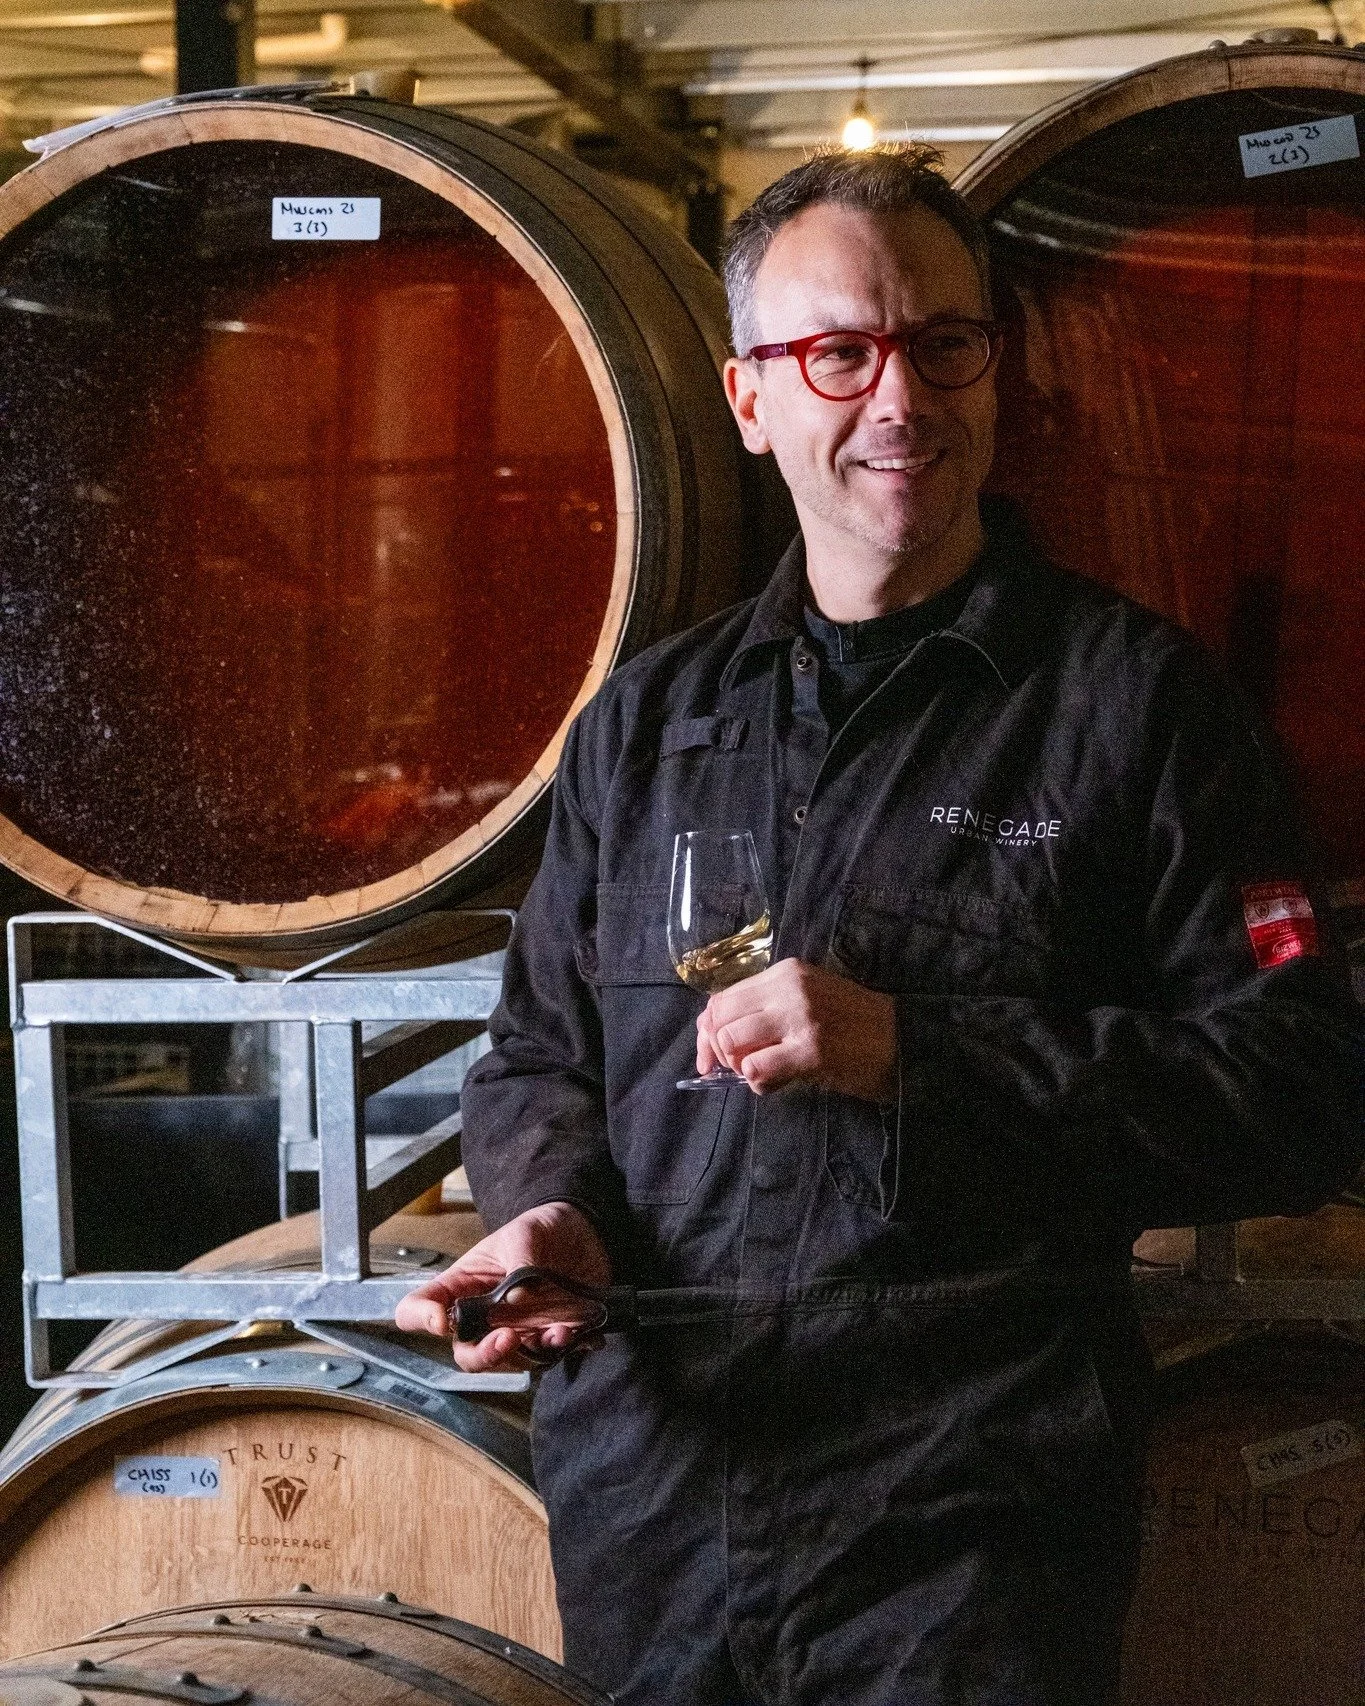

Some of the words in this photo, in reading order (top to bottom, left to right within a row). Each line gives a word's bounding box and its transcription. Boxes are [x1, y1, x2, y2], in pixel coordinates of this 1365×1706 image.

[930, 806, 1062, 838] RENEGADE
[950, 826, 989, 842] URBAN
[995, 837, 1038, 847] WINERY
[222, 1442, 346, 1471] TRUST
[238, 1535, 332, 1550] COOPERAGE
